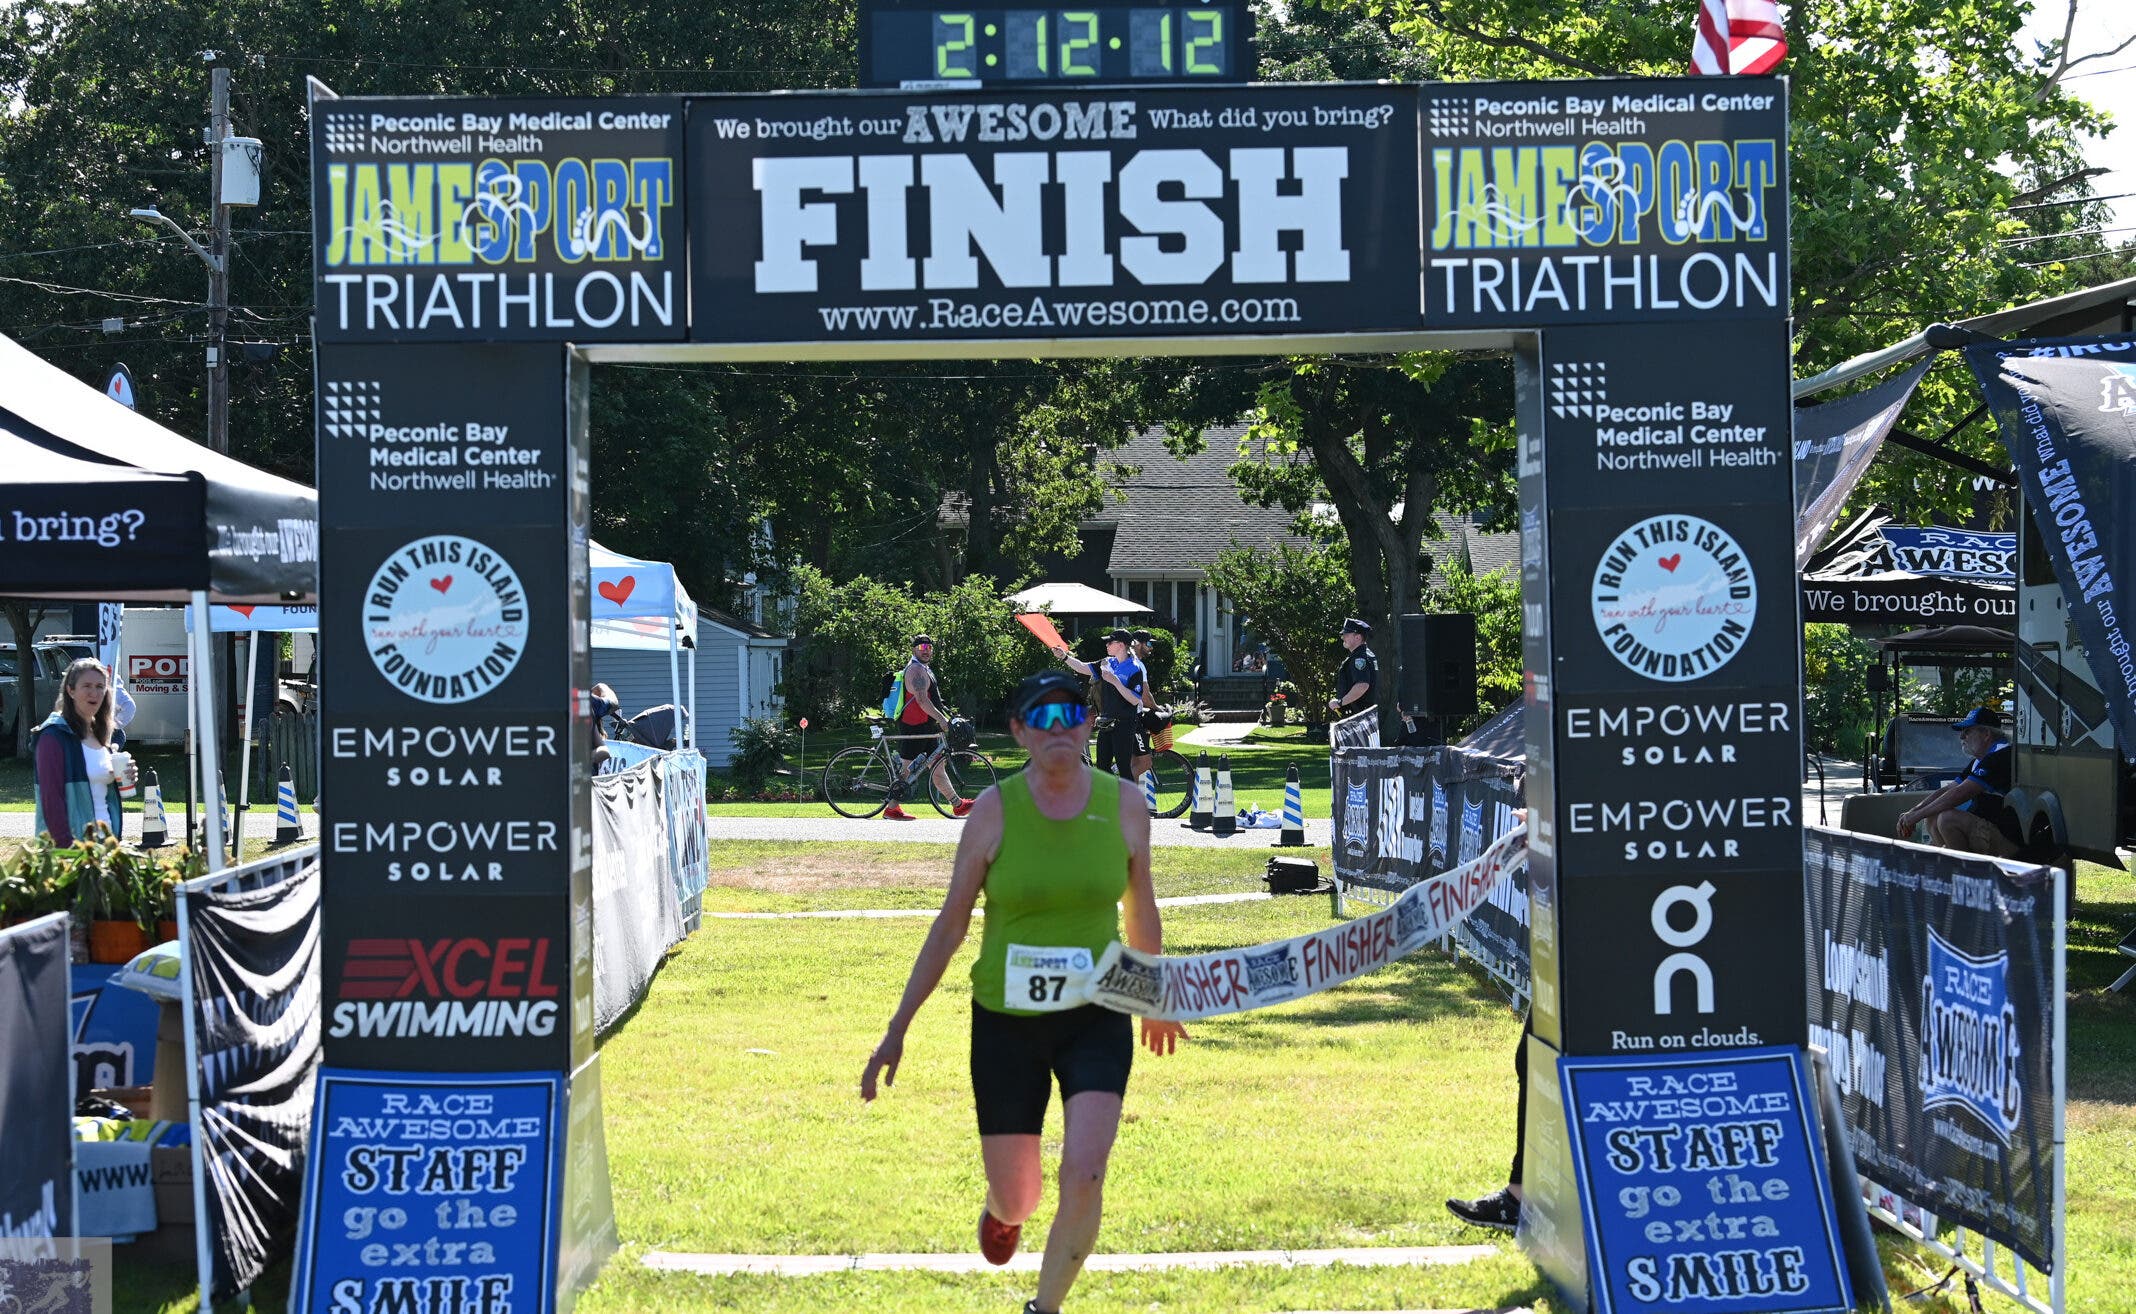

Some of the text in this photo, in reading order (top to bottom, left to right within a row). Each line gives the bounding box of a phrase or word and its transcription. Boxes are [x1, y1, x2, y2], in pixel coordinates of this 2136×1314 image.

[714, 100, 1395, 144] We brought our AWESOME What did you bring?
[1475, 93, 1774, 118] Peconic Bay Medical Center
[371, 111, 671, 136] Peconic Bay Medical Center
[1475, 116, 1646, 138] Northwell Health
[371, 133, 543, 155] Northwell Health
[325, 157, 673, 266] JAMESPORT
[1431, 139, 1777, 251] JAMESPORT
[752, 145, 1351, 294] FINISH
[1431, 252, 1777, 313] TRIATHLON
[324, 270, 673, 331] TRIATHLON
[819, 296, 1301, 332] www.RaceAwesome.com
[1595, 401, 1734, 424] Peconic Bay
[2021, 402, 2044, 425] did
[370, 422, 509, 446] Peconic Bay
[1596, 424, 1767, 447] Medical Center
[2031, 425, 2057, 464] What
[369, 446, 541, 467] Medical Center
[1597, 447, 1777, 471] Northwell Health
[370, 469, 552, 491] Northwell Health
[12, 508, 146, 548] bring?
[2037, 458, 2114, 605] AWESOME
[1599, 541, 1639, 590] RUN
[1633, 519, 1690, 549] THIS
[1692, 525, 1752, 601] ISLAND
[368, 541, 524, 623] I RUN THIS ISLAND
[1804, 589, 1845, 611] We
[1852, 589, 1967, 617] brought
[1603, 618, 1747, 678] FOUNDATION
[373, 641, 518, 699] FOUNDATION
[136, 684, 169, 694] Moving
[172, 684, 180, 692] &
[1567, 702, 1790, 739] EMPOWER
[332, 725, 558, 758] EMPOWER
[1622, 744, 1738, 766] SOLAR
[387, 766, 503, 787] SOLAR
[1570, 797, 1793, 834] EMPOWER
[334, 820, 559, 853] EMPOWER
[1625, 838, 1741, 861] SOLAR
[388, 861, 504, 882] SOLAR
[1302, 914, 1397, 988] FINISHER
[1029, 975, 1067, 1003] 87
[1944, 965, 1993, 1006] RACE
[328, 1000, 559, 1039] SWIMMING
[1611, 1026, 1764, 1050] Run on clouds.
[1918, 975, 2022, 1132] AWESOME
[1627, 1072, 1738, 1096] RACE
[382, 1094, 493, 1115] RACE
[1584, 1092, 1790, 1123] AWESOME
[329, 1117, 540, 1140] AWESOME
[1606, 1119, 1784, 1173] STAFF
[342, 1143, 527, 1195] STAFF
[1618, 1173, 1790, 1219] go the
[342, 1199, 518, 1240] go the
[1644, 1211, 1780, 1244] extra
[360, 1236, 496, 1267] extra
[1625, 1245, 1810, 1303] SMILE
